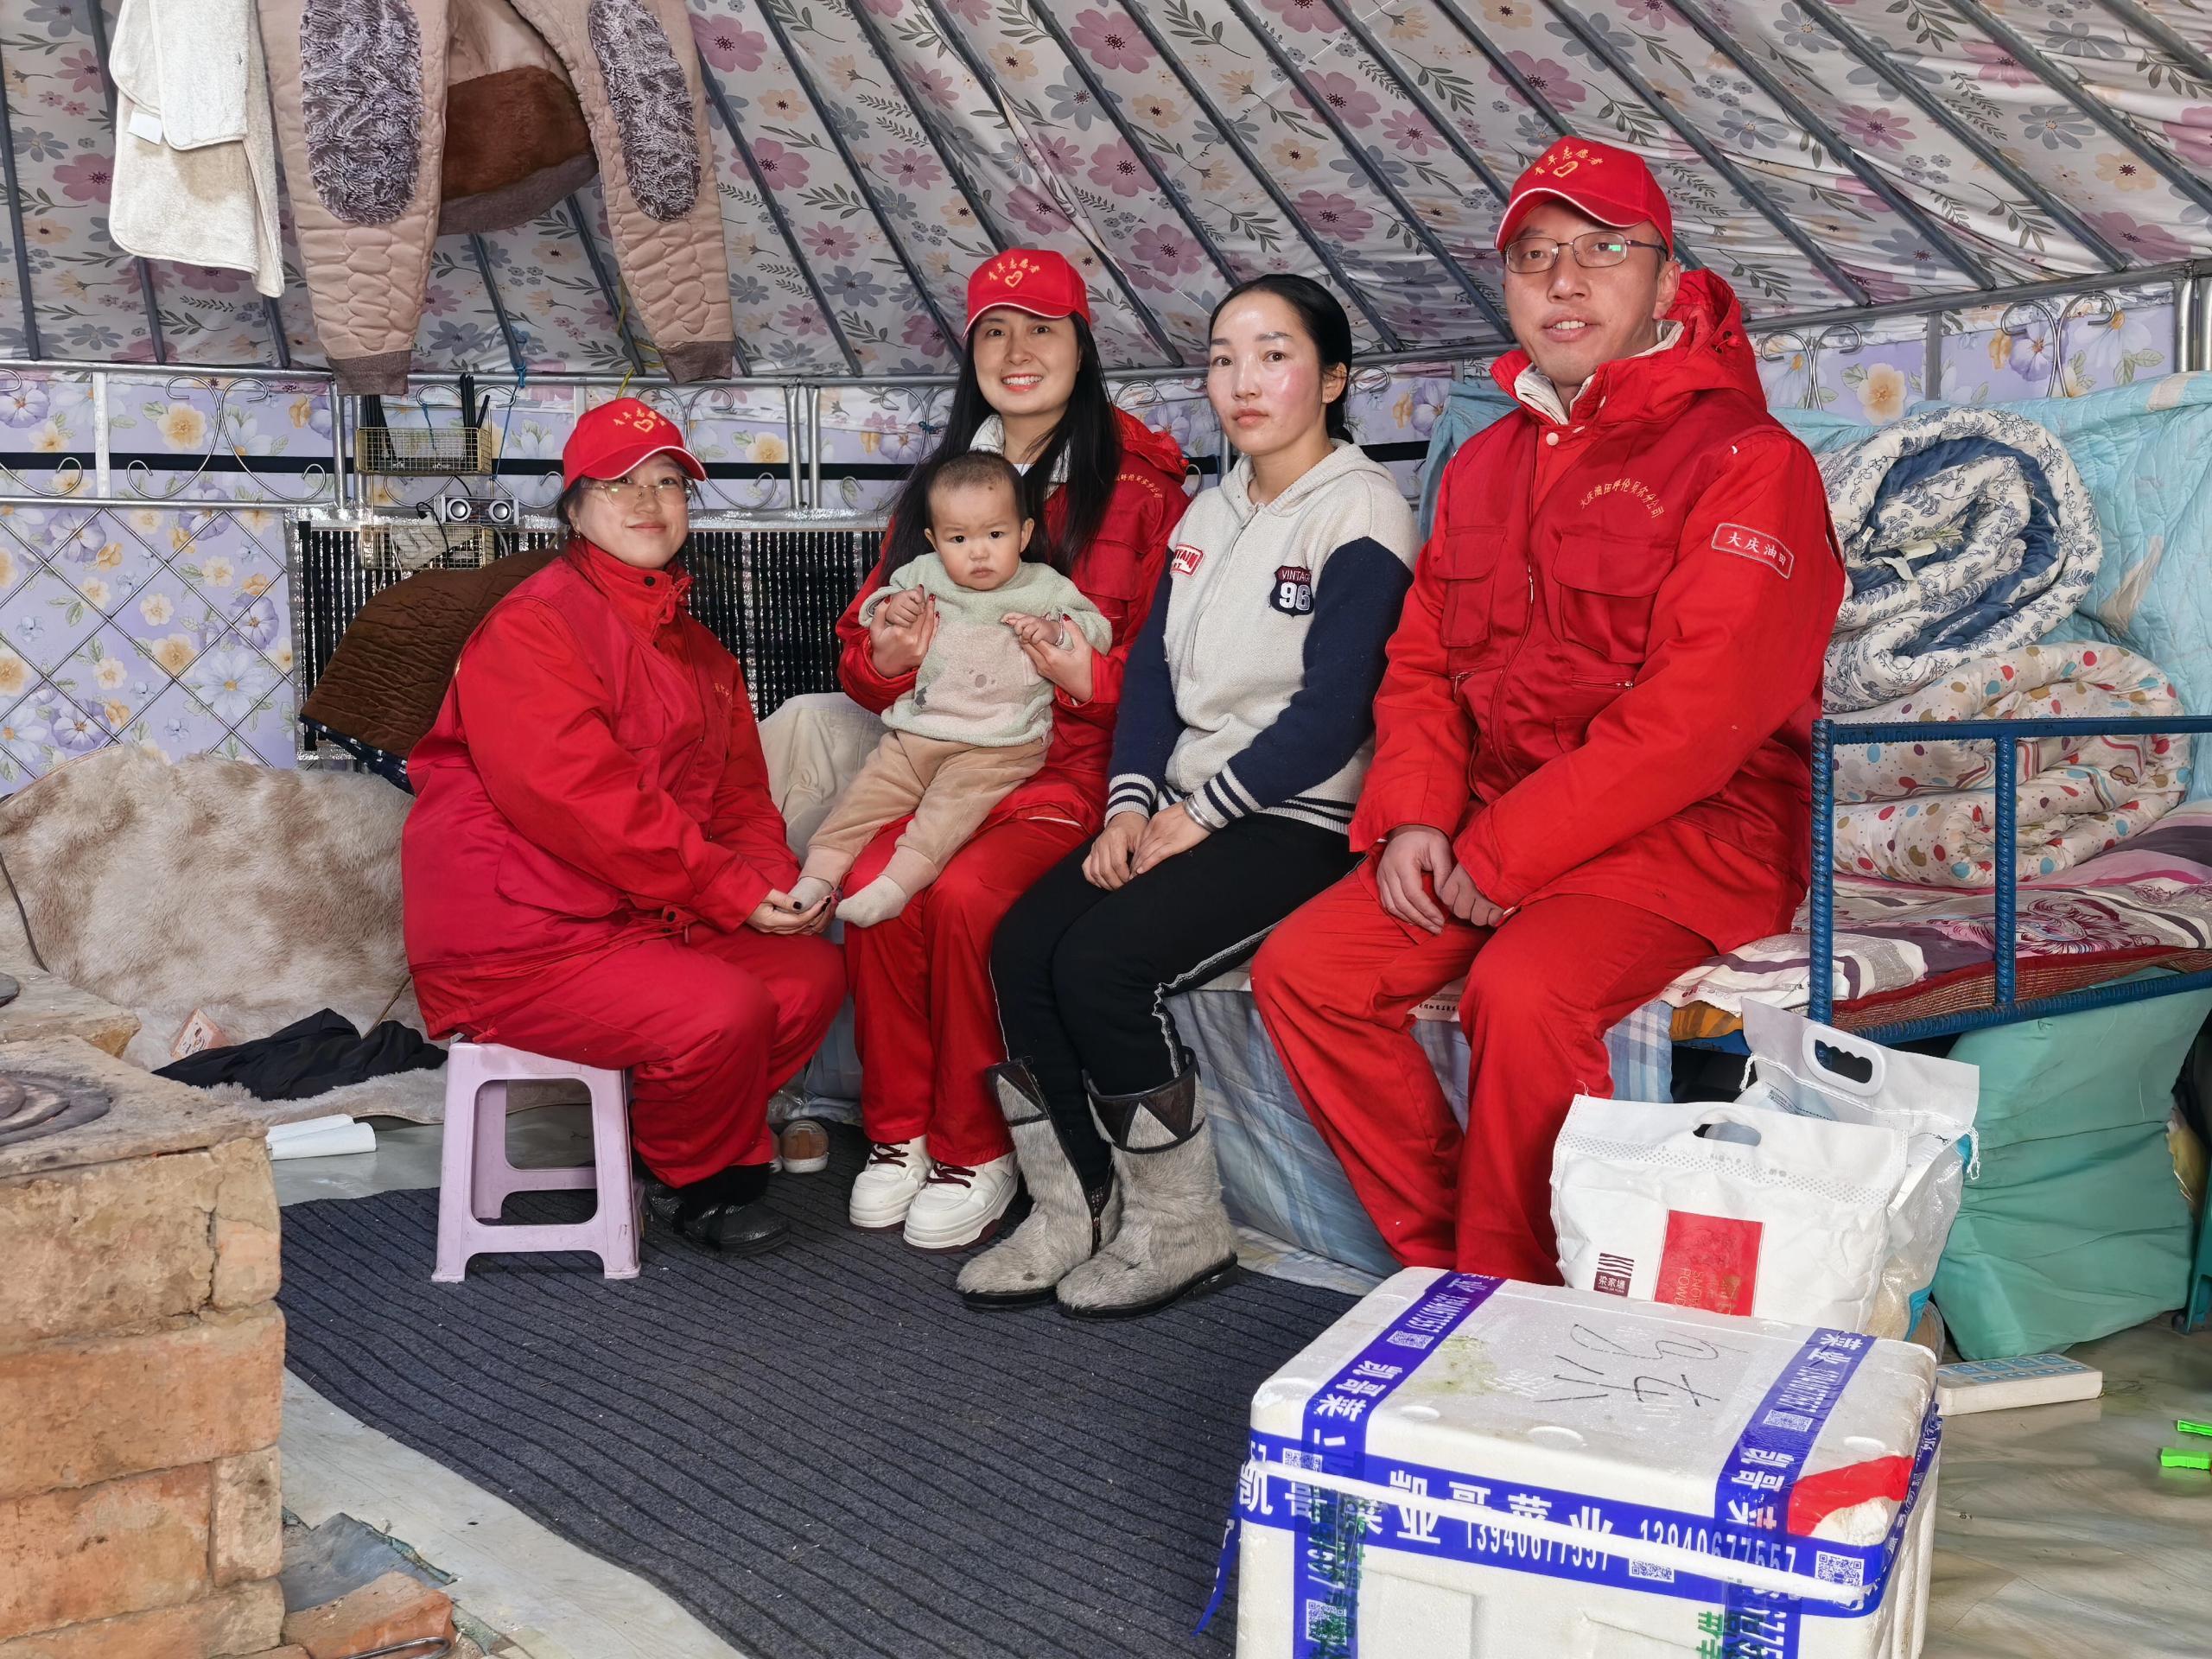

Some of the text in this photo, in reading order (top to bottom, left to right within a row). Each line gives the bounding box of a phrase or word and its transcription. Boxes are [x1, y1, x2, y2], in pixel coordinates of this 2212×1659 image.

[1725, 531, 1787, 566] 大庆油田
[1279, 582, 1312, 611] 96
